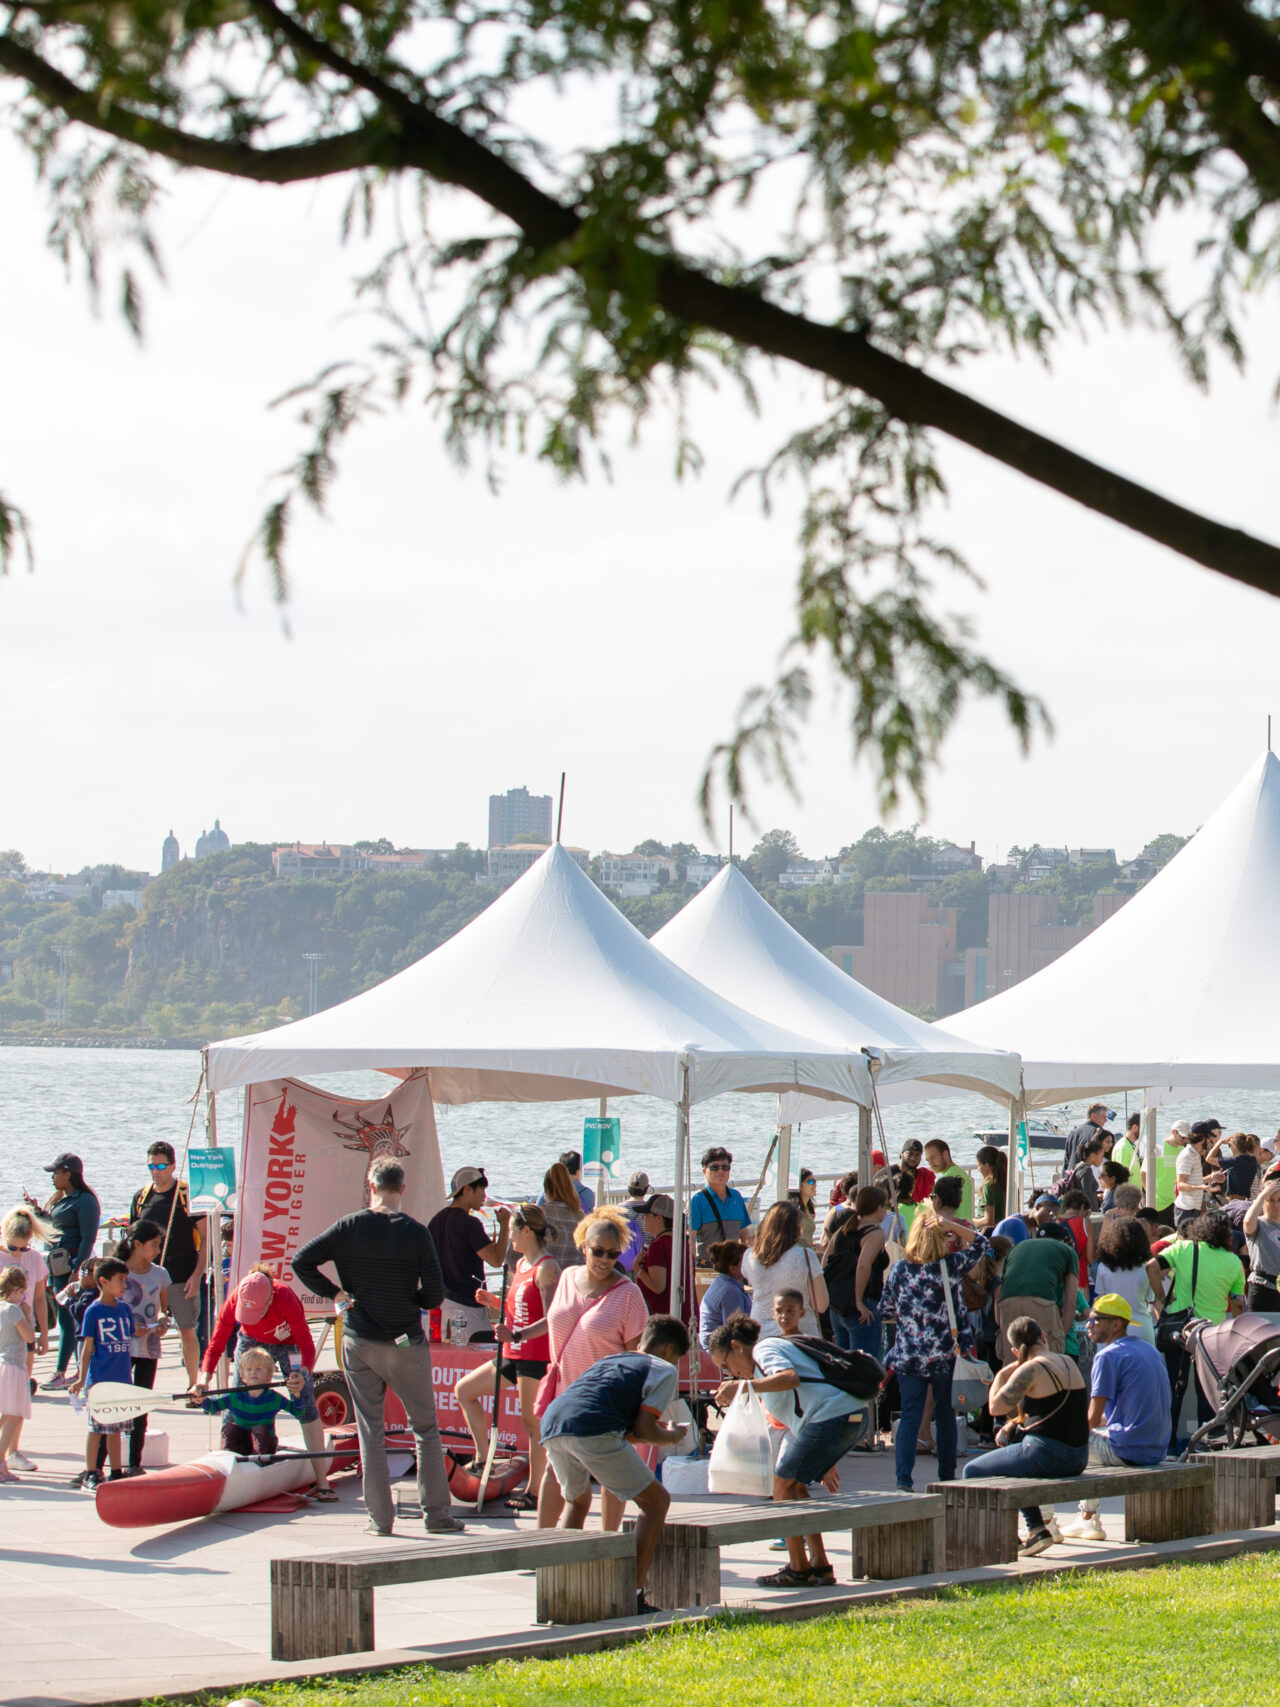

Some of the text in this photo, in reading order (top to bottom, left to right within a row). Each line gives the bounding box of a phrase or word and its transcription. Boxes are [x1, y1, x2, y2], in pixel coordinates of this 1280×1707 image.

[190, 1161, 224, 1170] Outrigger
[260, 1133, 296, 1281] EW YORK
[282, 1153, 307, 1282] OUTRIGGER
[300, 1293, 315, 1305] Find
[316, 1296, 324, 1304] us
